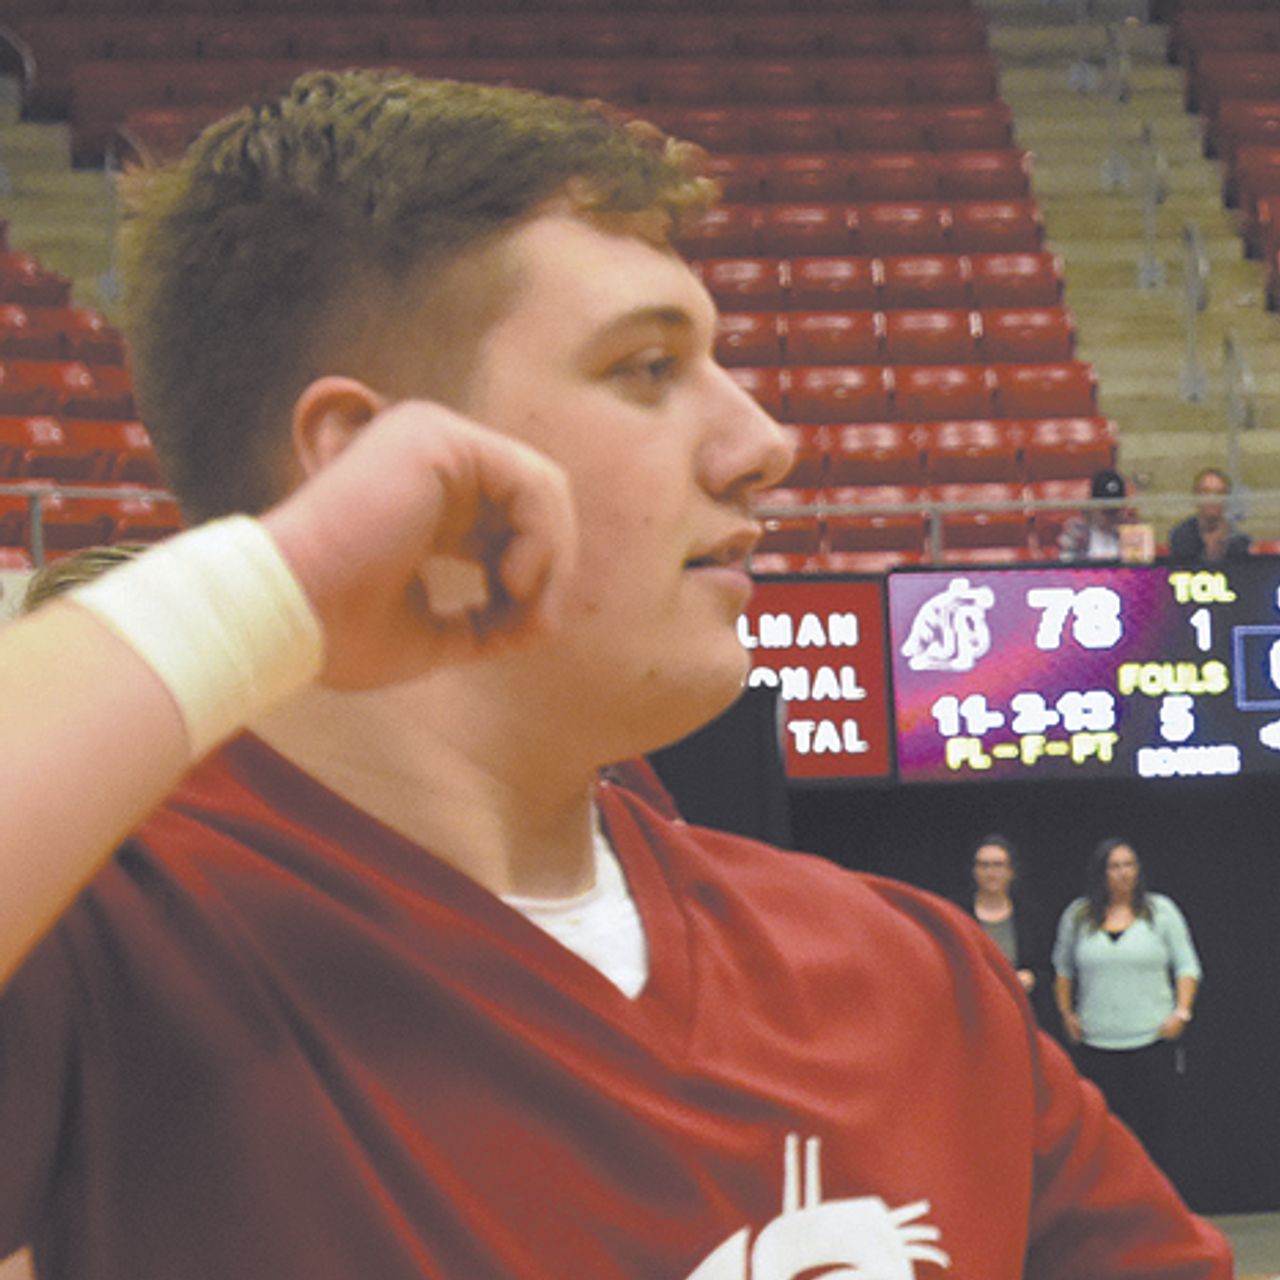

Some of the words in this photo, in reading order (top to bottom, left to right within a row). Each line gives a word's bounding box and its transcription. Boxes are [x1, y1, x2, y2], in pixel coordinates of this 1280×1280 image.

[1168, 570, 1236, 604] TOL
[1026, 586, 1124, 650] 78
[1189, 607, 1211, 651] 1
[1118, 660, 1230, 696] FOULS
